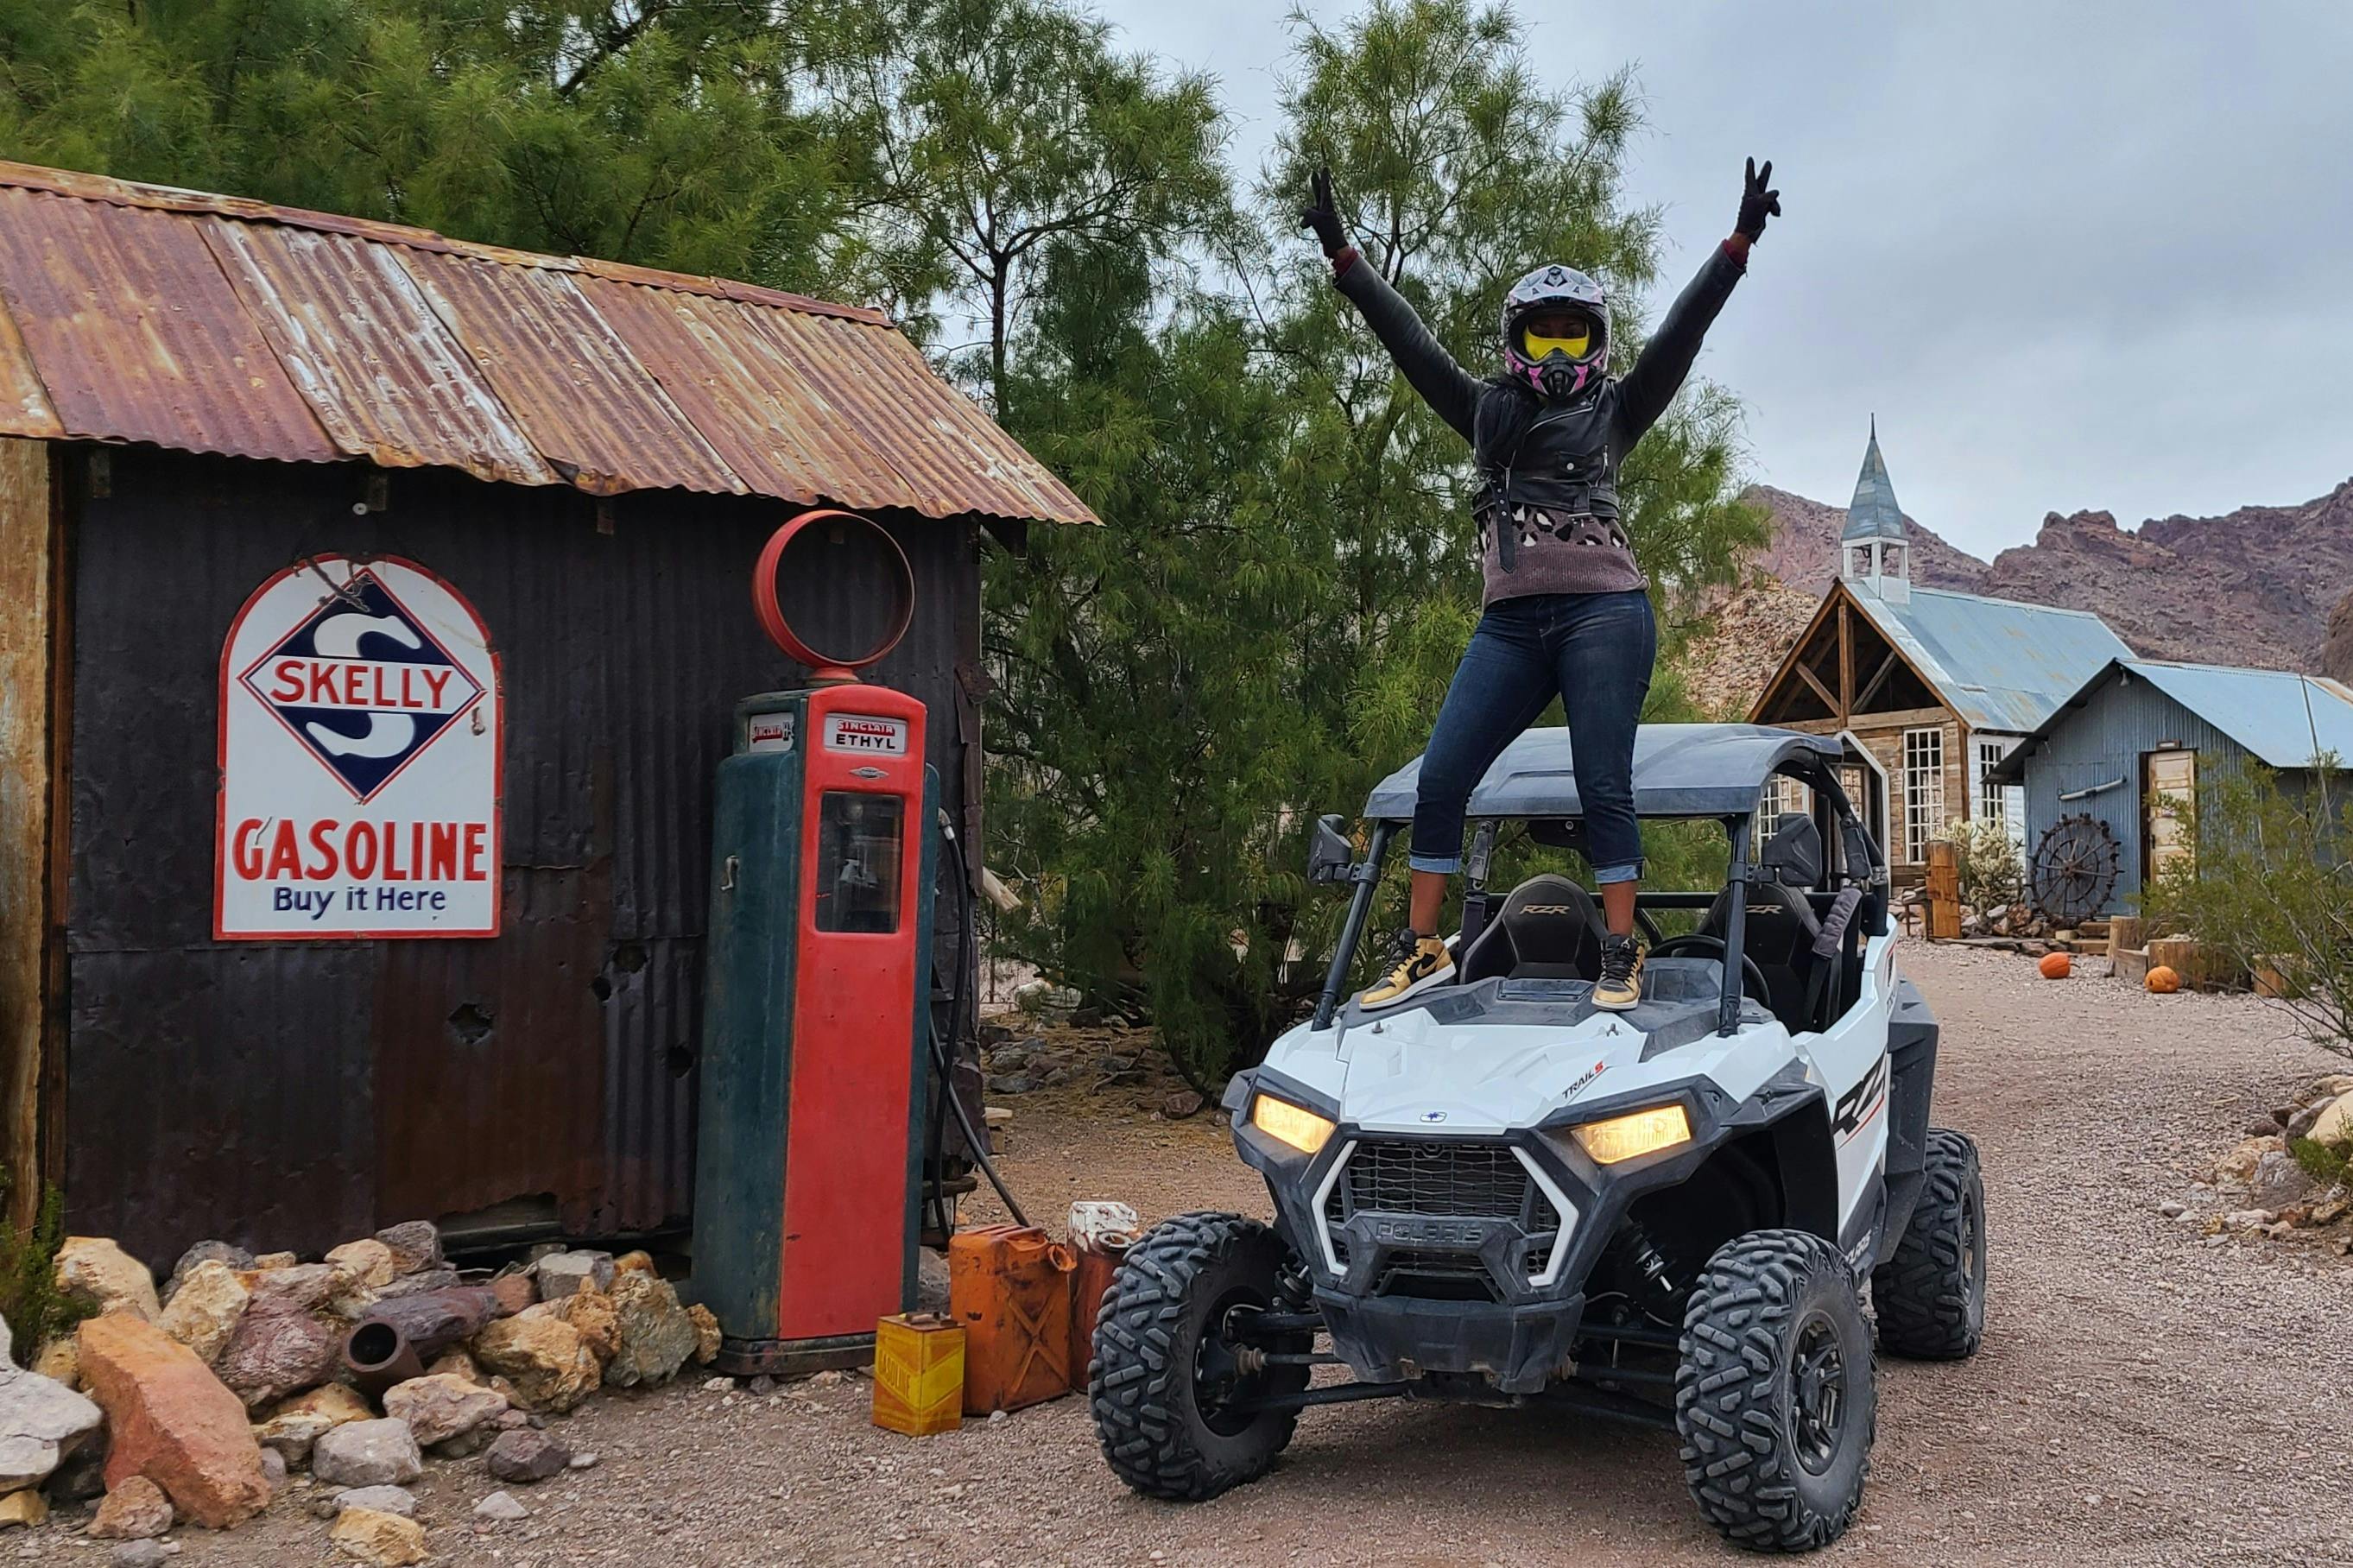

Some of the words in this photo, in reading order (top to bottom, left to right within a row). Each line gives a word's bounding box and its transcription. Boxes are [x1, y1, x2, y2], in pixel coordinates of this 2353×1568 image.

[269, 660, 452, 709] SKELLY
[837, 719, 895, 737] SINCLAIR
[836, 734, 895, 749] ETHYL
[231, 819, 488, 882] GASOLINE
[273, 886, 336, 920] Buy
[345, 886, 368, 911] it
[376, 886, 446, 911] Here
[1520, 905, 1571, 915] RZR
[1745, 904, 1783, 914] ZR
[1376, 1222, 1483, 1244] POLARIS
